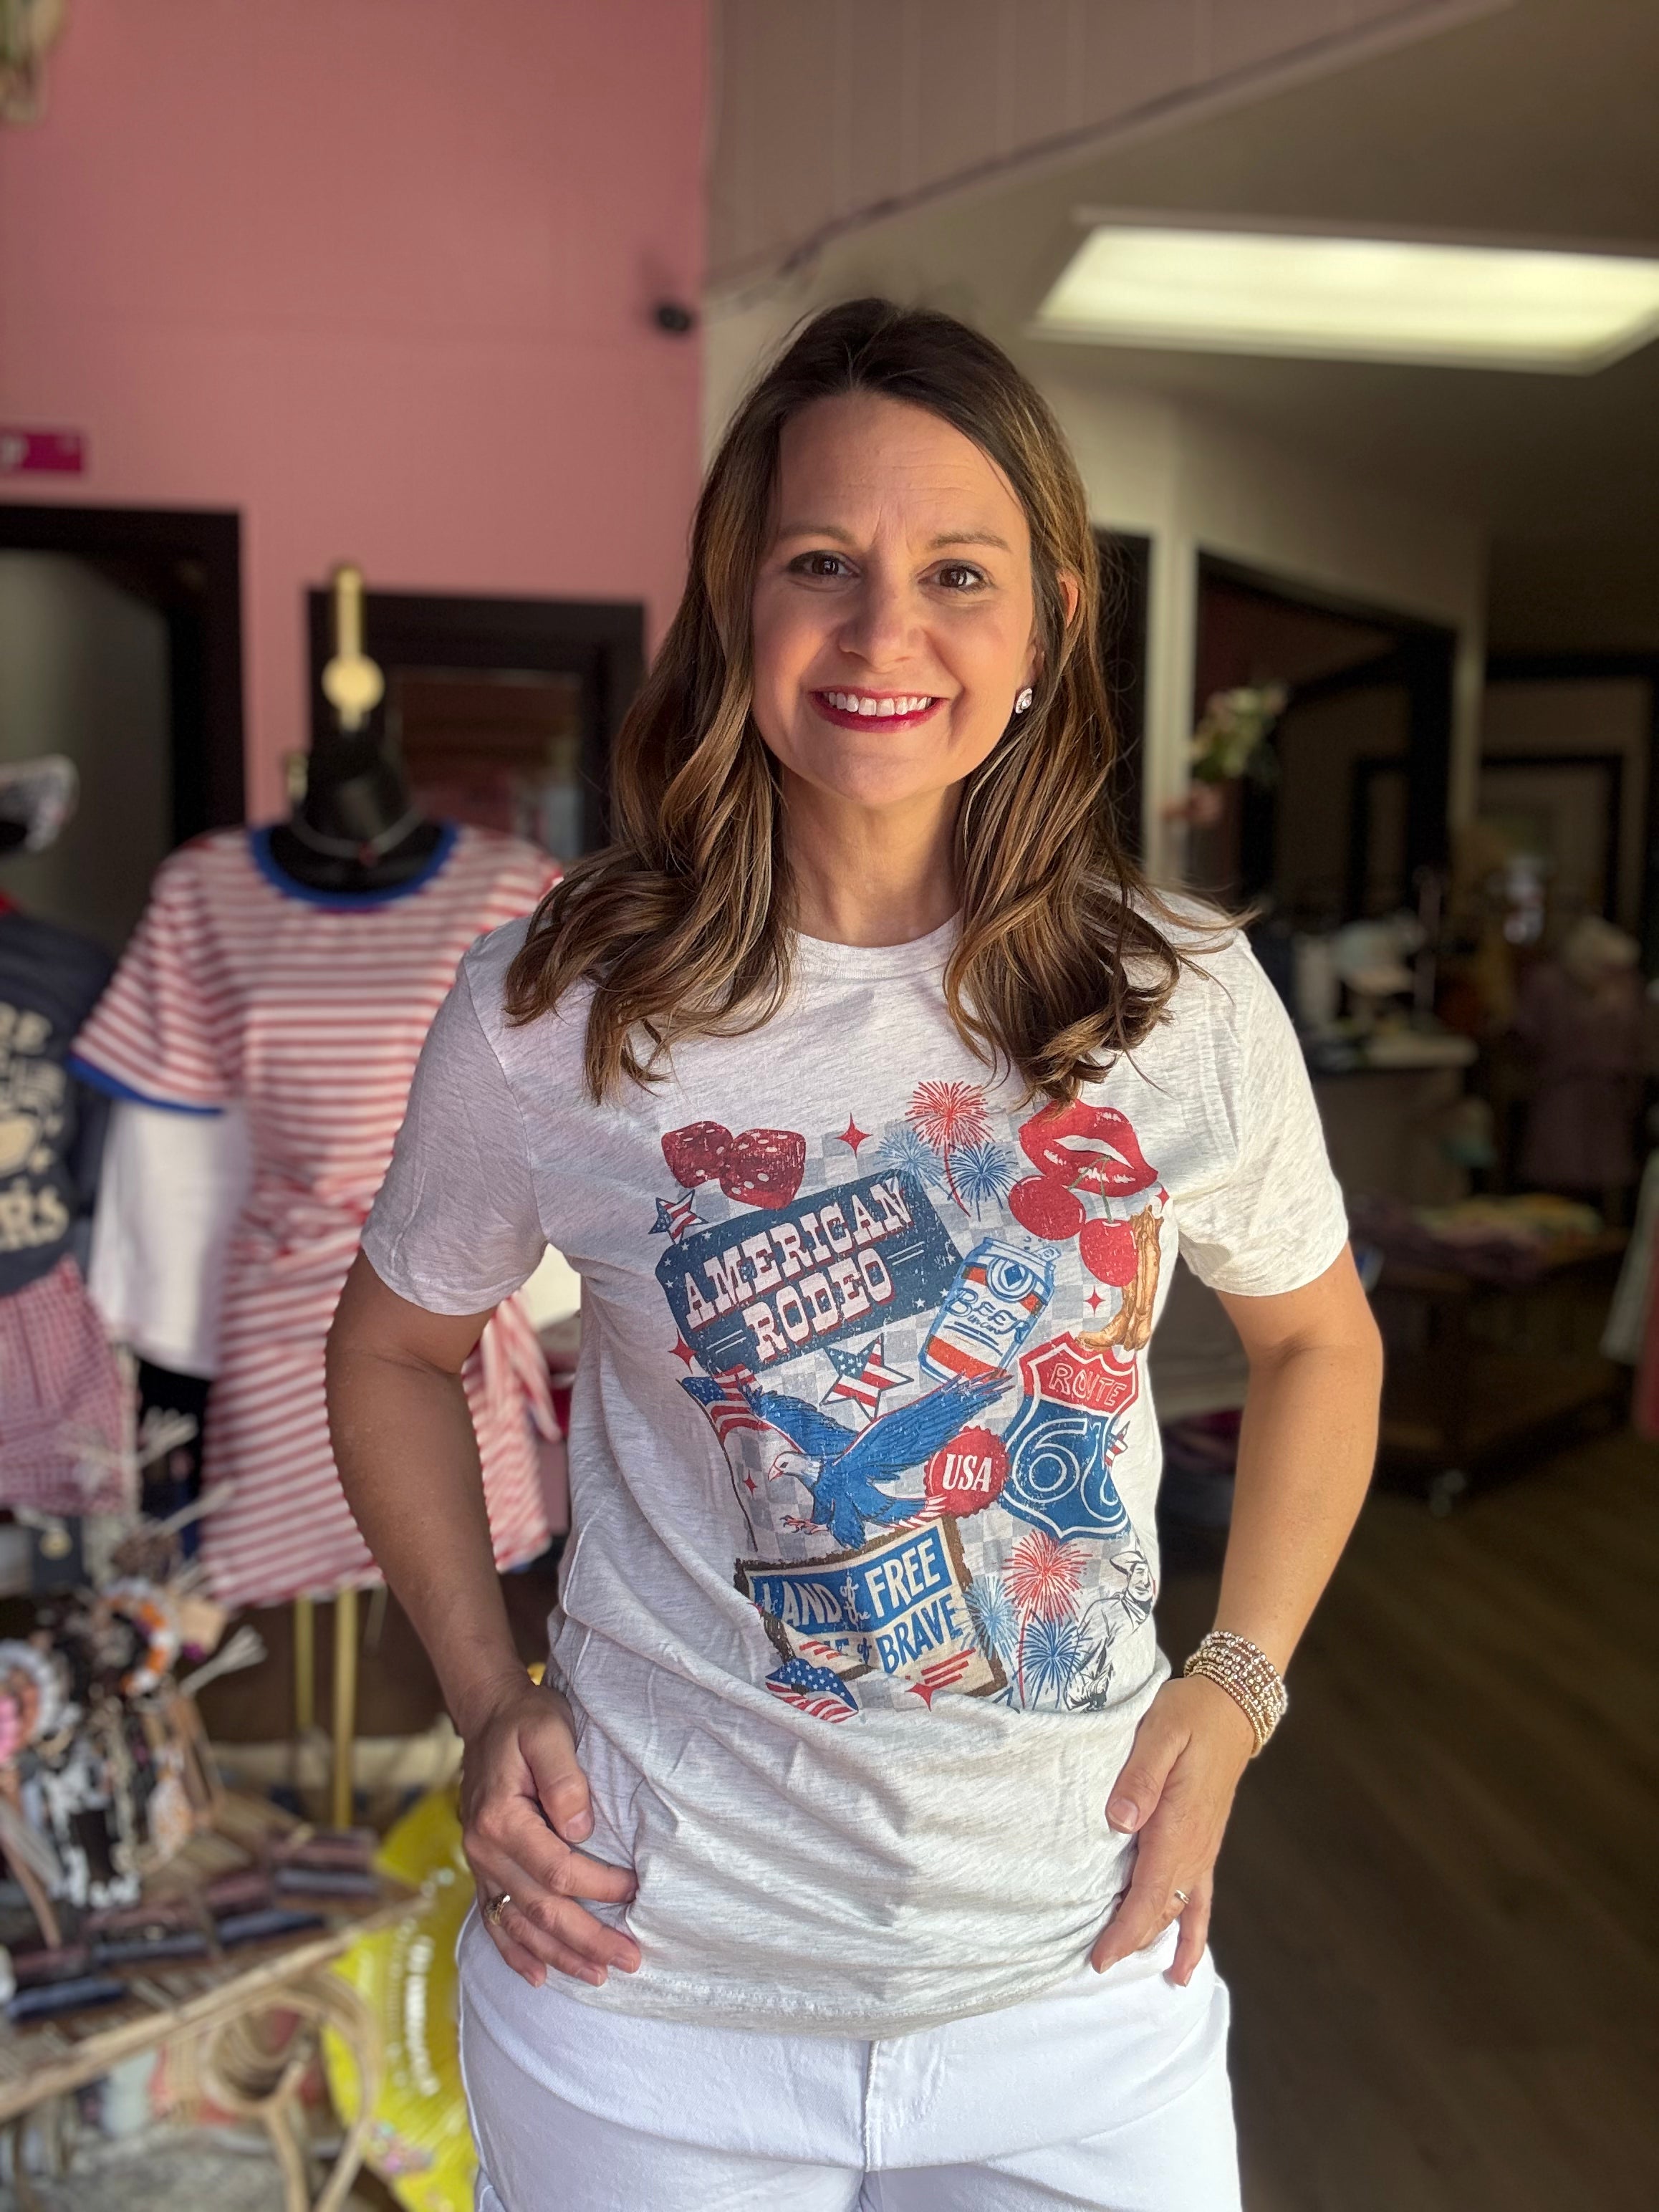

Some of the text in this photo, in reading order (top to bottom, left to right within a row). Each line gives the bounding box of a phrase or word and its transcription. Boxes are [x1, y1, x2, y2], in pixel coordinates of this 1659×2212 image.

[684, 1176, 913, 1331] AMERICAN
[743, 1248, 894, 1361] RODEO
[944, 1287, 1031, 1344] BEER
[1049, 1362, 1127, 1407] ROUTE
[942, 1453, 993, 1492] USA
[865, 1538, 941, 1617] FREE
[876, 1594, 963, 1674] BRAVE
